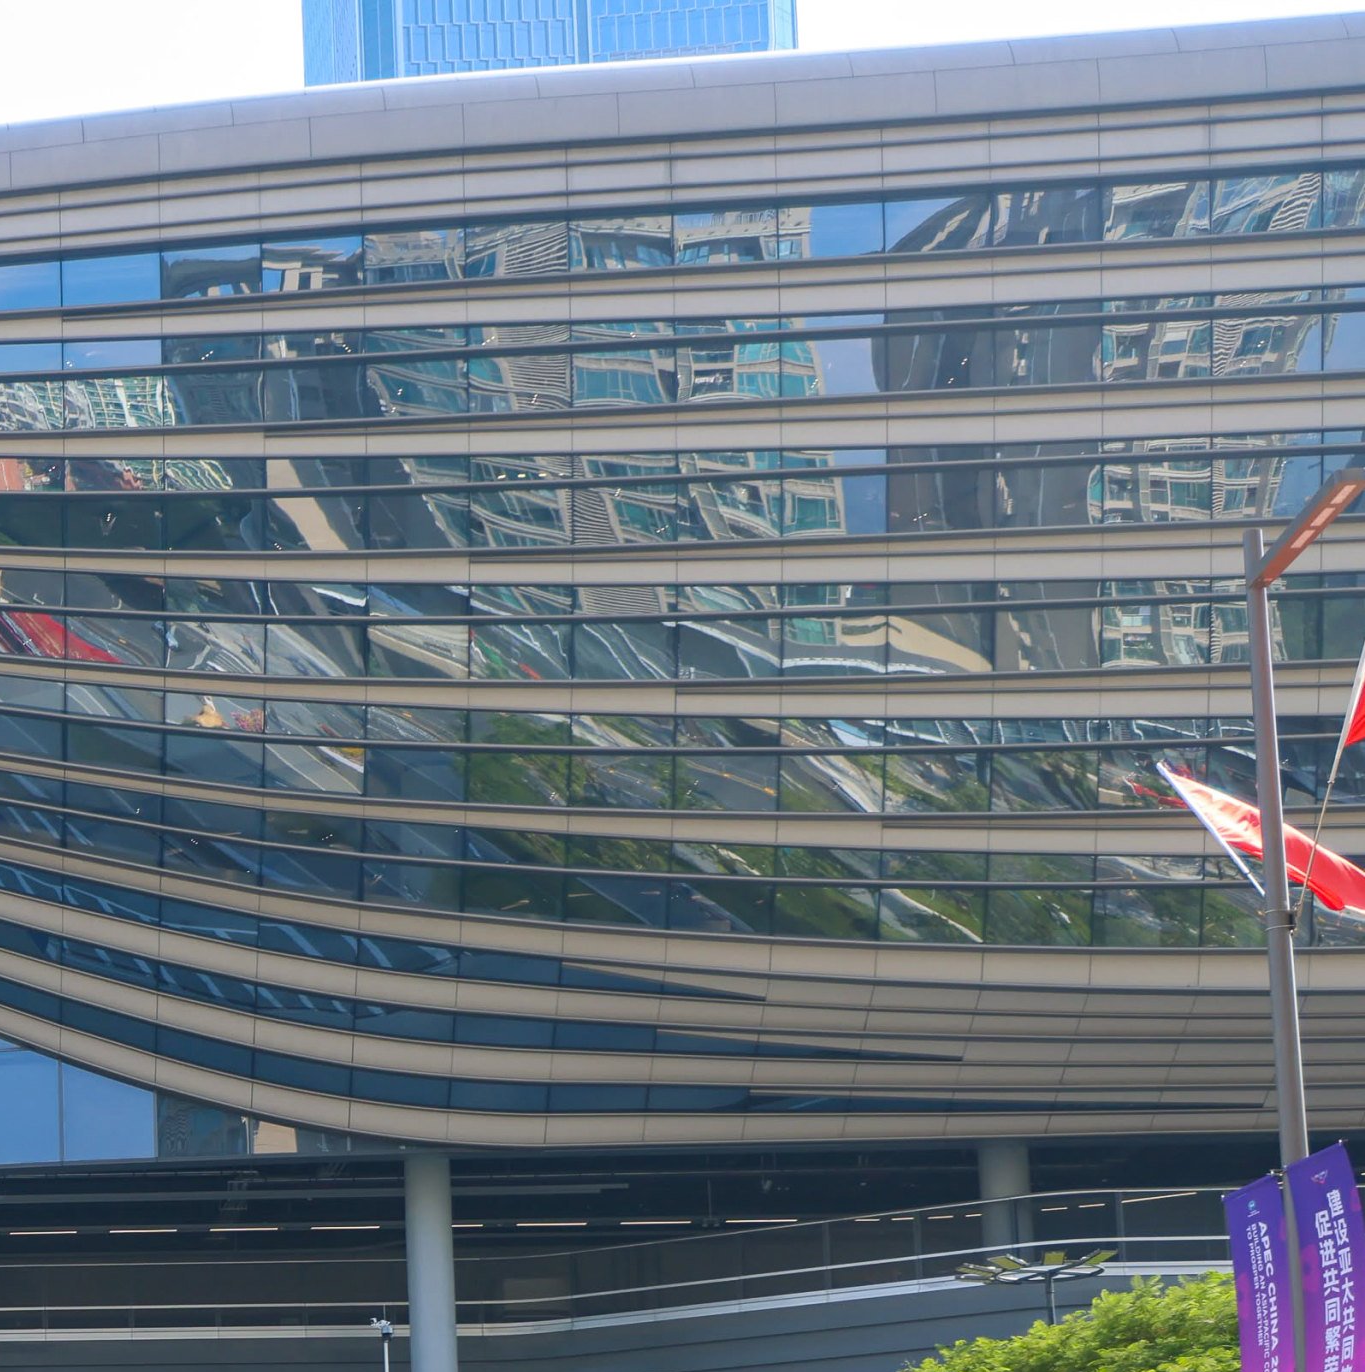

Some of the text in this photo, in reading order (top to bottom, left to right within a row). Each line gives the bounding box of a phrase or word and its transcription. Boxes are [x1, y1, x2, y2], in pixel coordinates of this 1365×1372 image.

[1246, 1226, 1264, 1346] TO PROSPER TOGETHER
[1251, 1223, 1264, 1272] BUILDING
[1259, 1275, 1266, 1290] AN
[1258, 1221, 1274, 1278] APEC
[1268, 1282, 1279, 1351] CHINA
